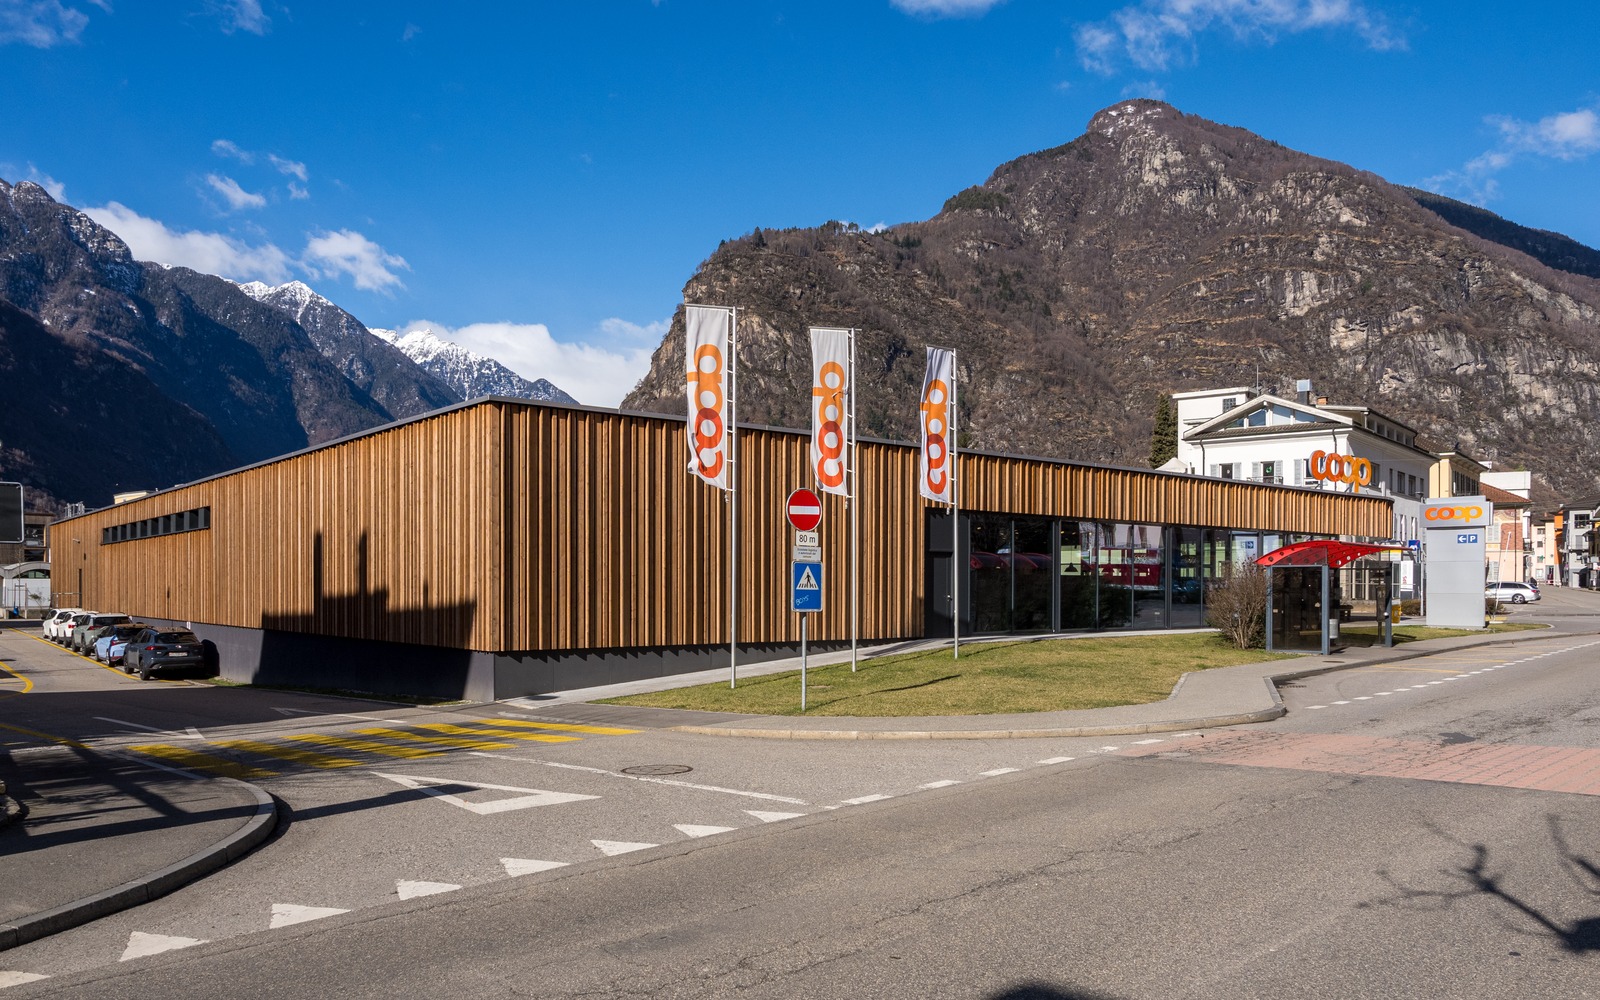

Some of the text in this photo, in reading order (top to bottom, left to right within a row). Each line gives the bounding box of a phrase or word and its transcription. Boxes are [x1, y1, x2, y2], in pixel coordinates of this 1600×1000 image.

[686, 344, 723, 478] coop
[812, 361, 845, 487] coop
[920, 379, 948, 494] coop
[1310, 450, 1372, 493] coop
[798, 534, 808, 542] 80
[1425, 506, 1483, 522] coop
